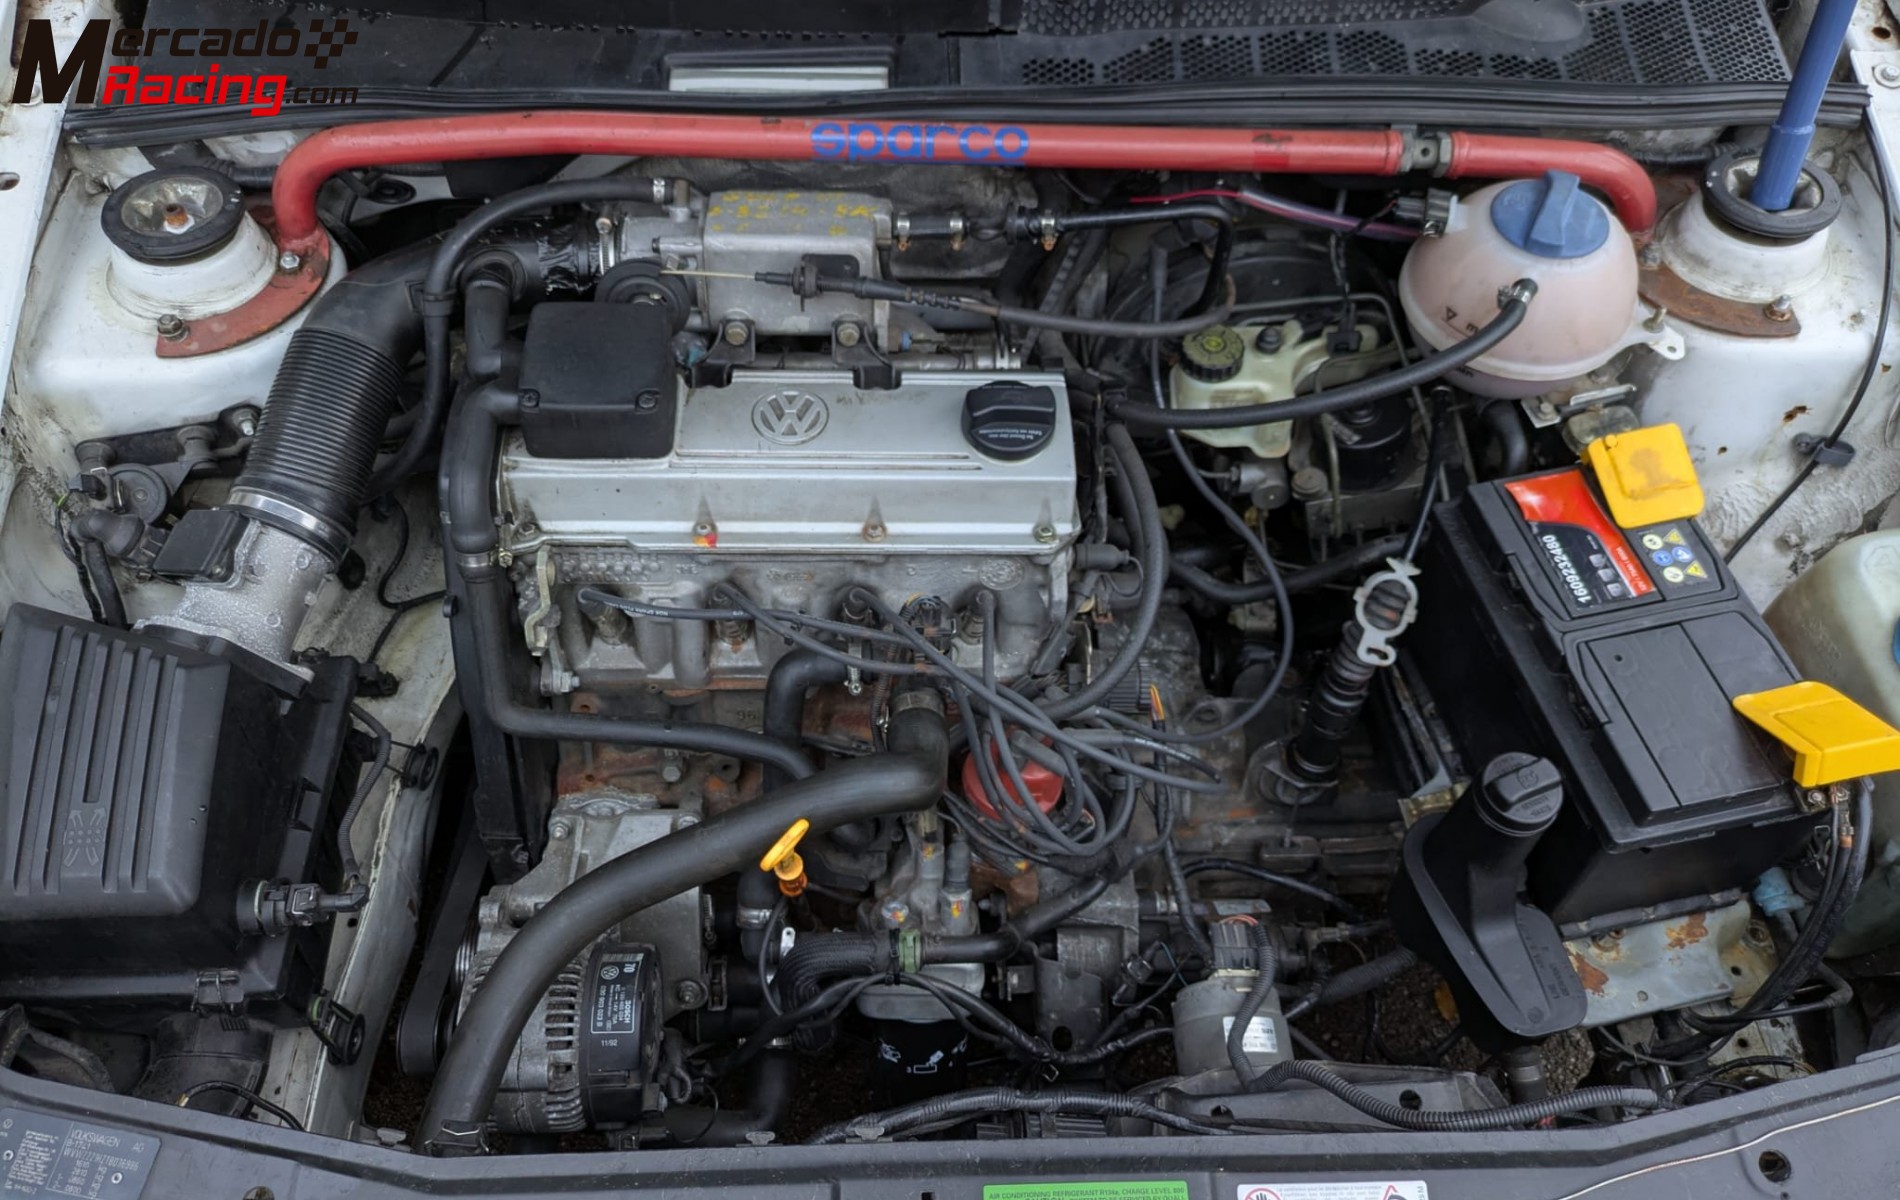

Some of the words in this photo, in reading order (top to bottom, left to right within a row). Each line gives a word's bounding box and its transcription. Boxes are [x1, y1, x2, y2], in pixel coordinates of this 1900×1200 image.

[811, 122, 1030, 160] sparco
[1542, 534, 1592, 603] 1609232480
[624, 1000, 632, 1024] BOSCH
[71, 1128, 121, 1148] VOLKSWAGEN
